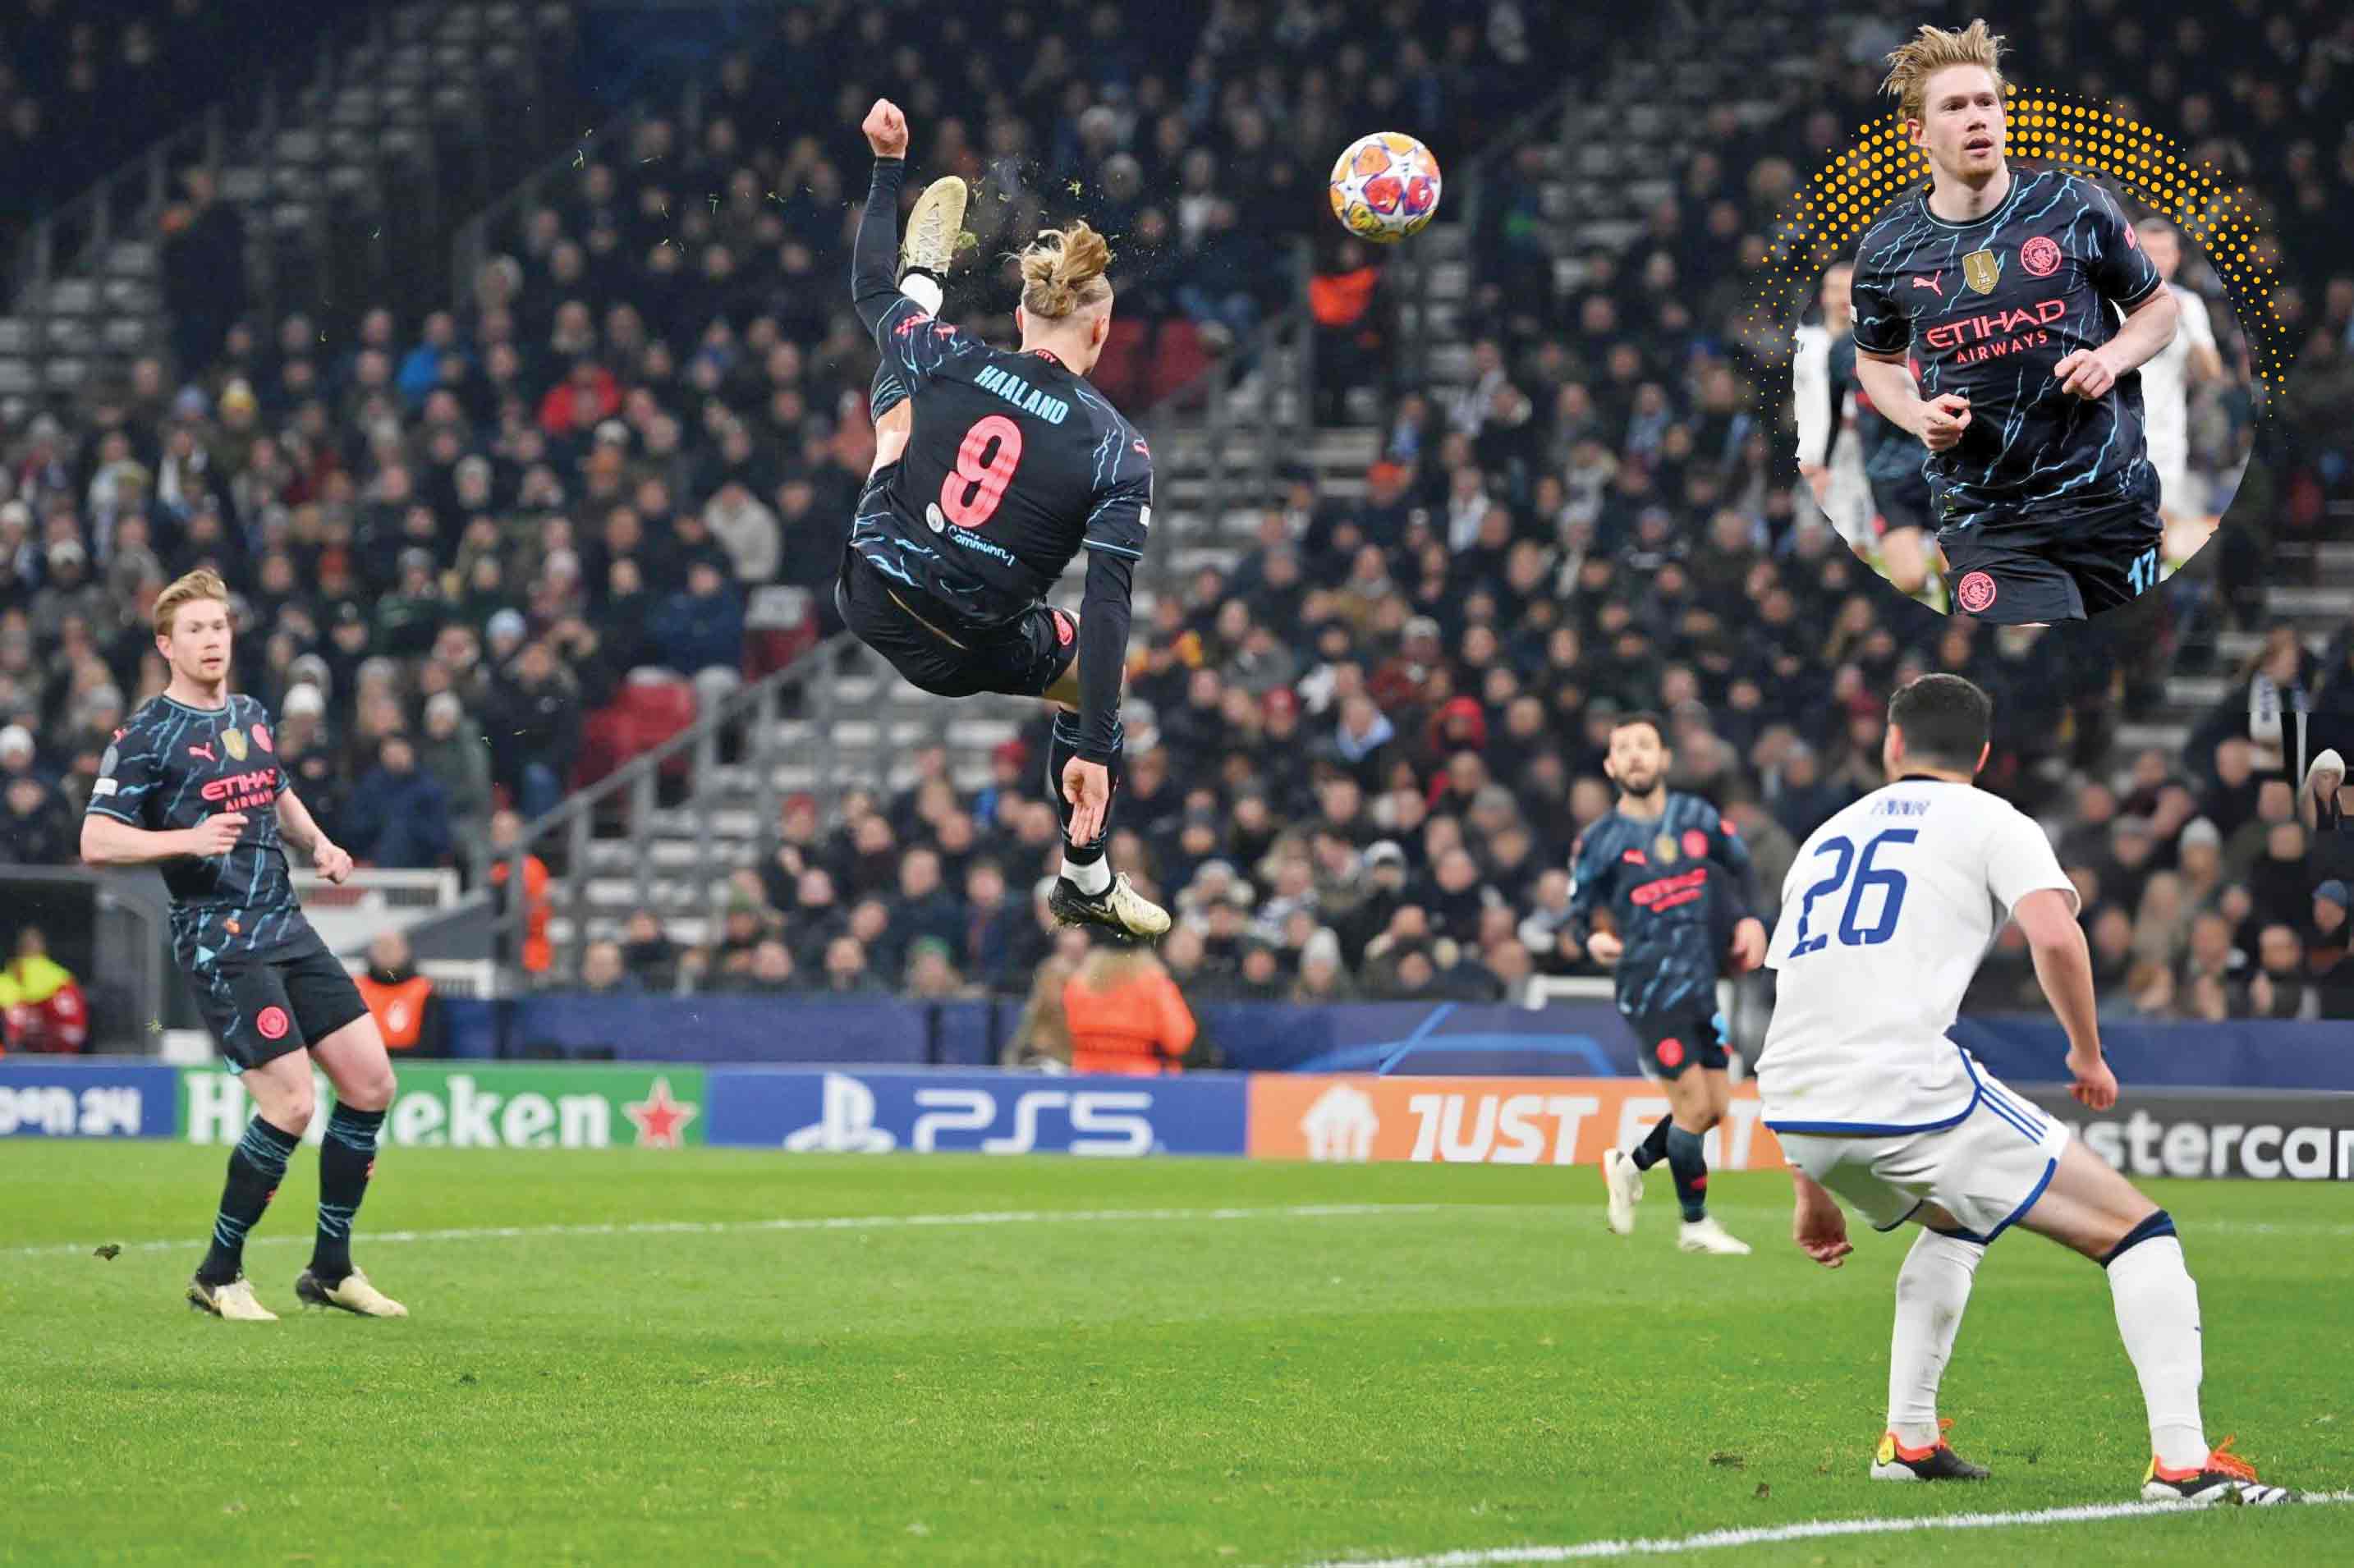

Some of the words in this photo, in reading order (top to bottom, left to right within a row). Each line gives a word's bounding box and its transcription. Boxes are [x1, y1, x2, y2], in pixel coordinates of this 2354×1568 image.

[1926, 299, 2066, 348] ETIHAD
[1957, 330, 2048, 364] AIRWAYS
[974, 364, 1069, 424] HAALAND
[940, 415, 1021, 528] 9
[2128, 548, 2156, 597] 17
[1788, 828, 1919, 959] 26
[914, 1089, 1154, 1157] PS5
[1407, 1093, 1599, 1166] JUST
[1615, 1097, 1764, 1171] ET
